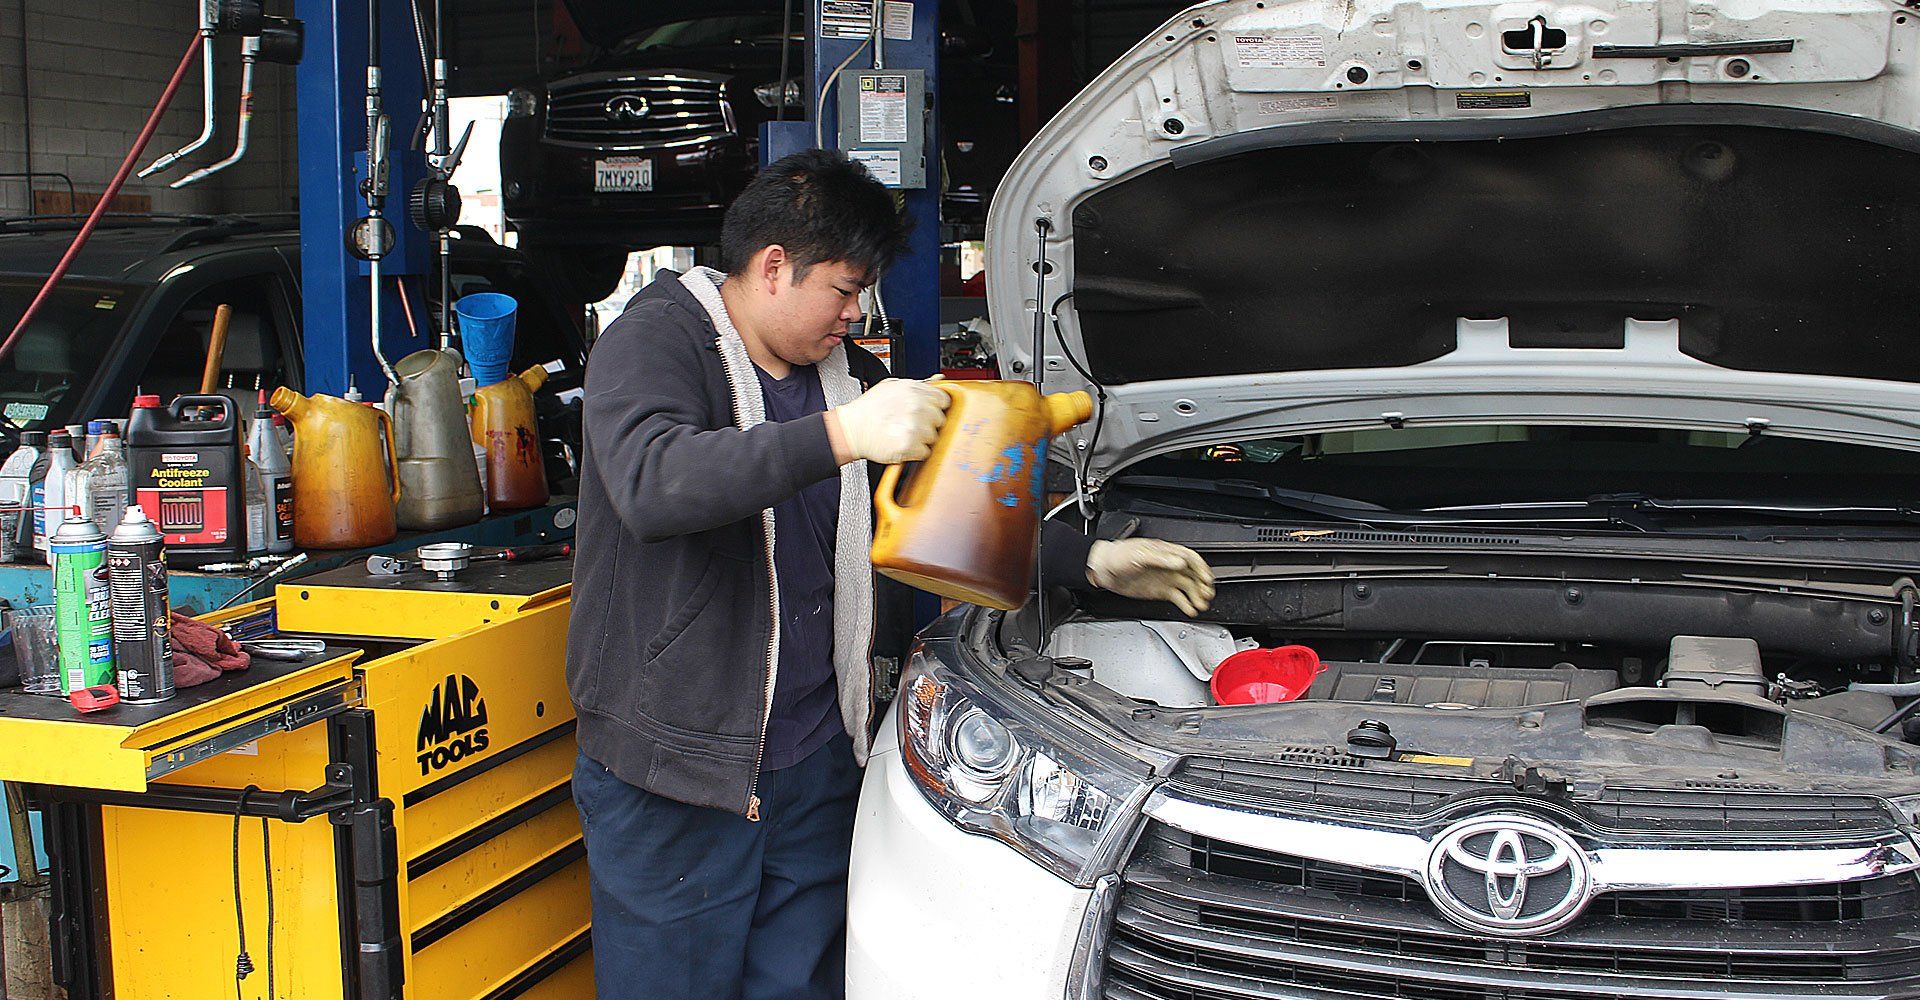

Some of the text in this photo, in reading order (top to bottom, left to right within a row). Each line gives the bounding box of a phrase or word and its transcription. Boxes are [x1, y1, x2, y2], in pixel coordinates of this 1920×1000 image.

[598, 170, 650, 187] 7MYW910
[151, 468, 210, 478] Antifreeze
[158, 478, 204, 488] Coolant
[416, 673, 489, 753] MAC
[416, 728, 490, 776] TOOLS
